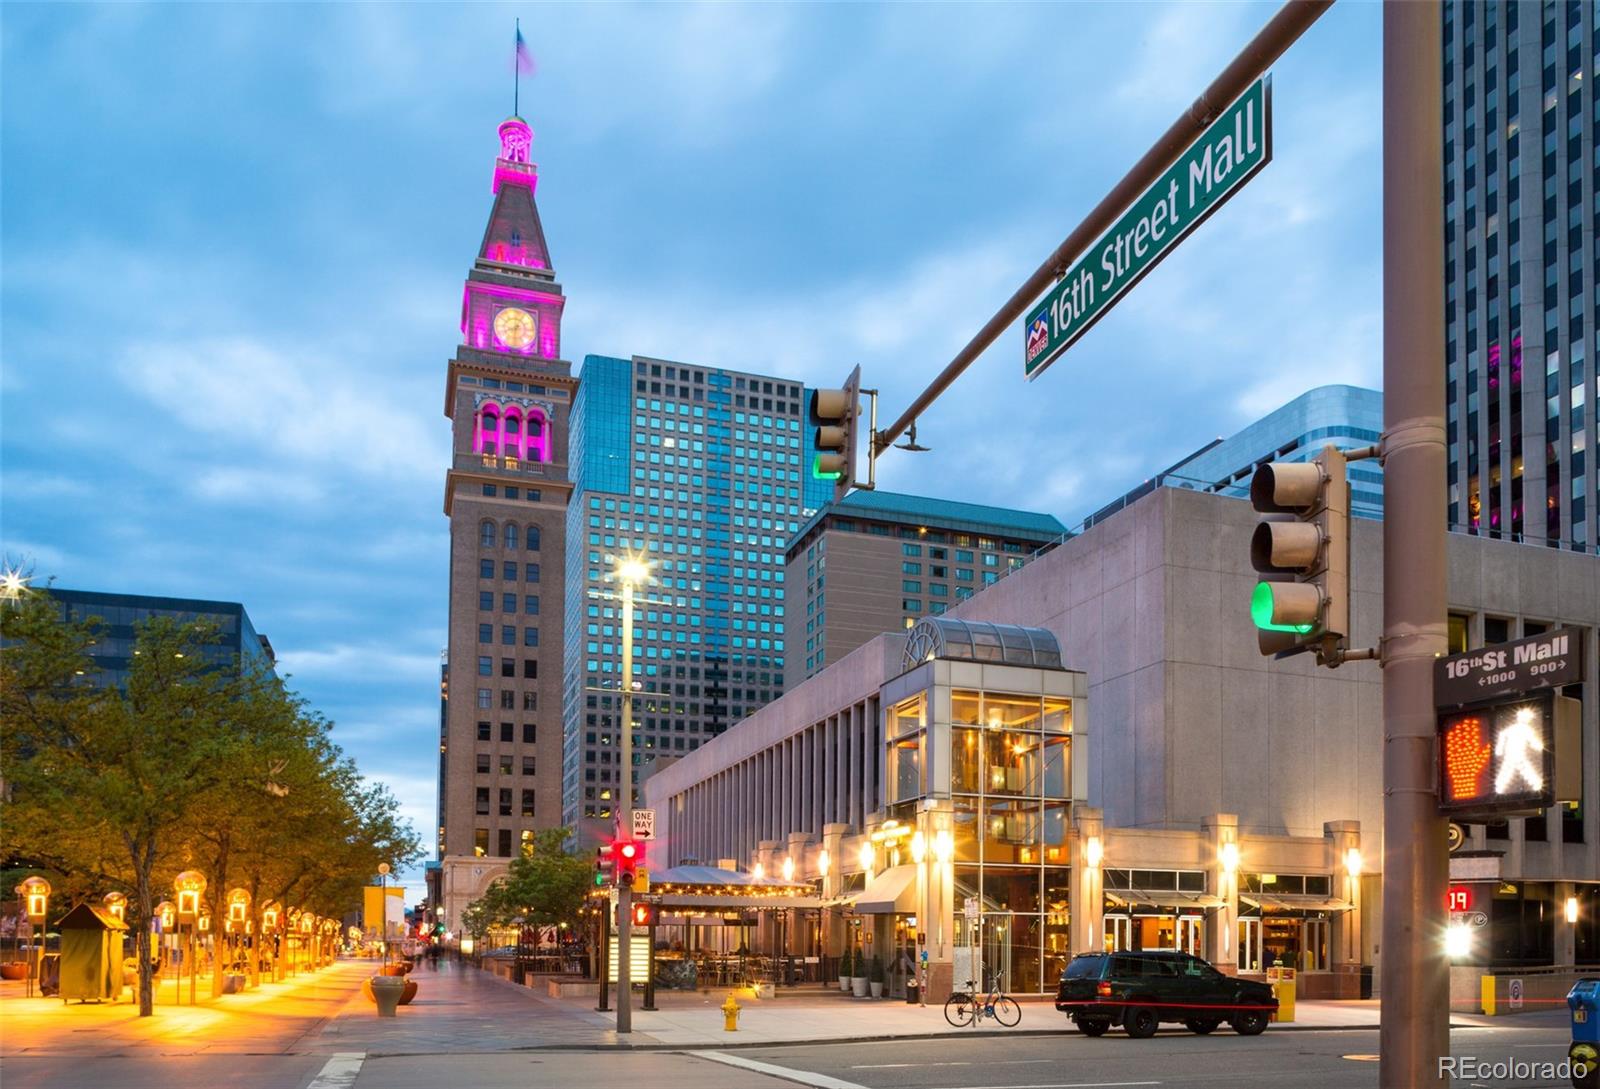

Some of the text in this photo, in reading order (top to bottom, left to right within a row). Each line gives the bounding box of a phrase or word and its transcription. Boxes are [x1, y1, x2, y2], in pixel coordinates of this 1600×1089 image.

[1050, 98, 1256, 338] 16th Street Mall
[1513, 635, 1569, 665] Mall
[1486, 662, 1557, 685] 1000 900
[635, 812, 652, 820] ONE
[635, 821, 652, 829] WAY
